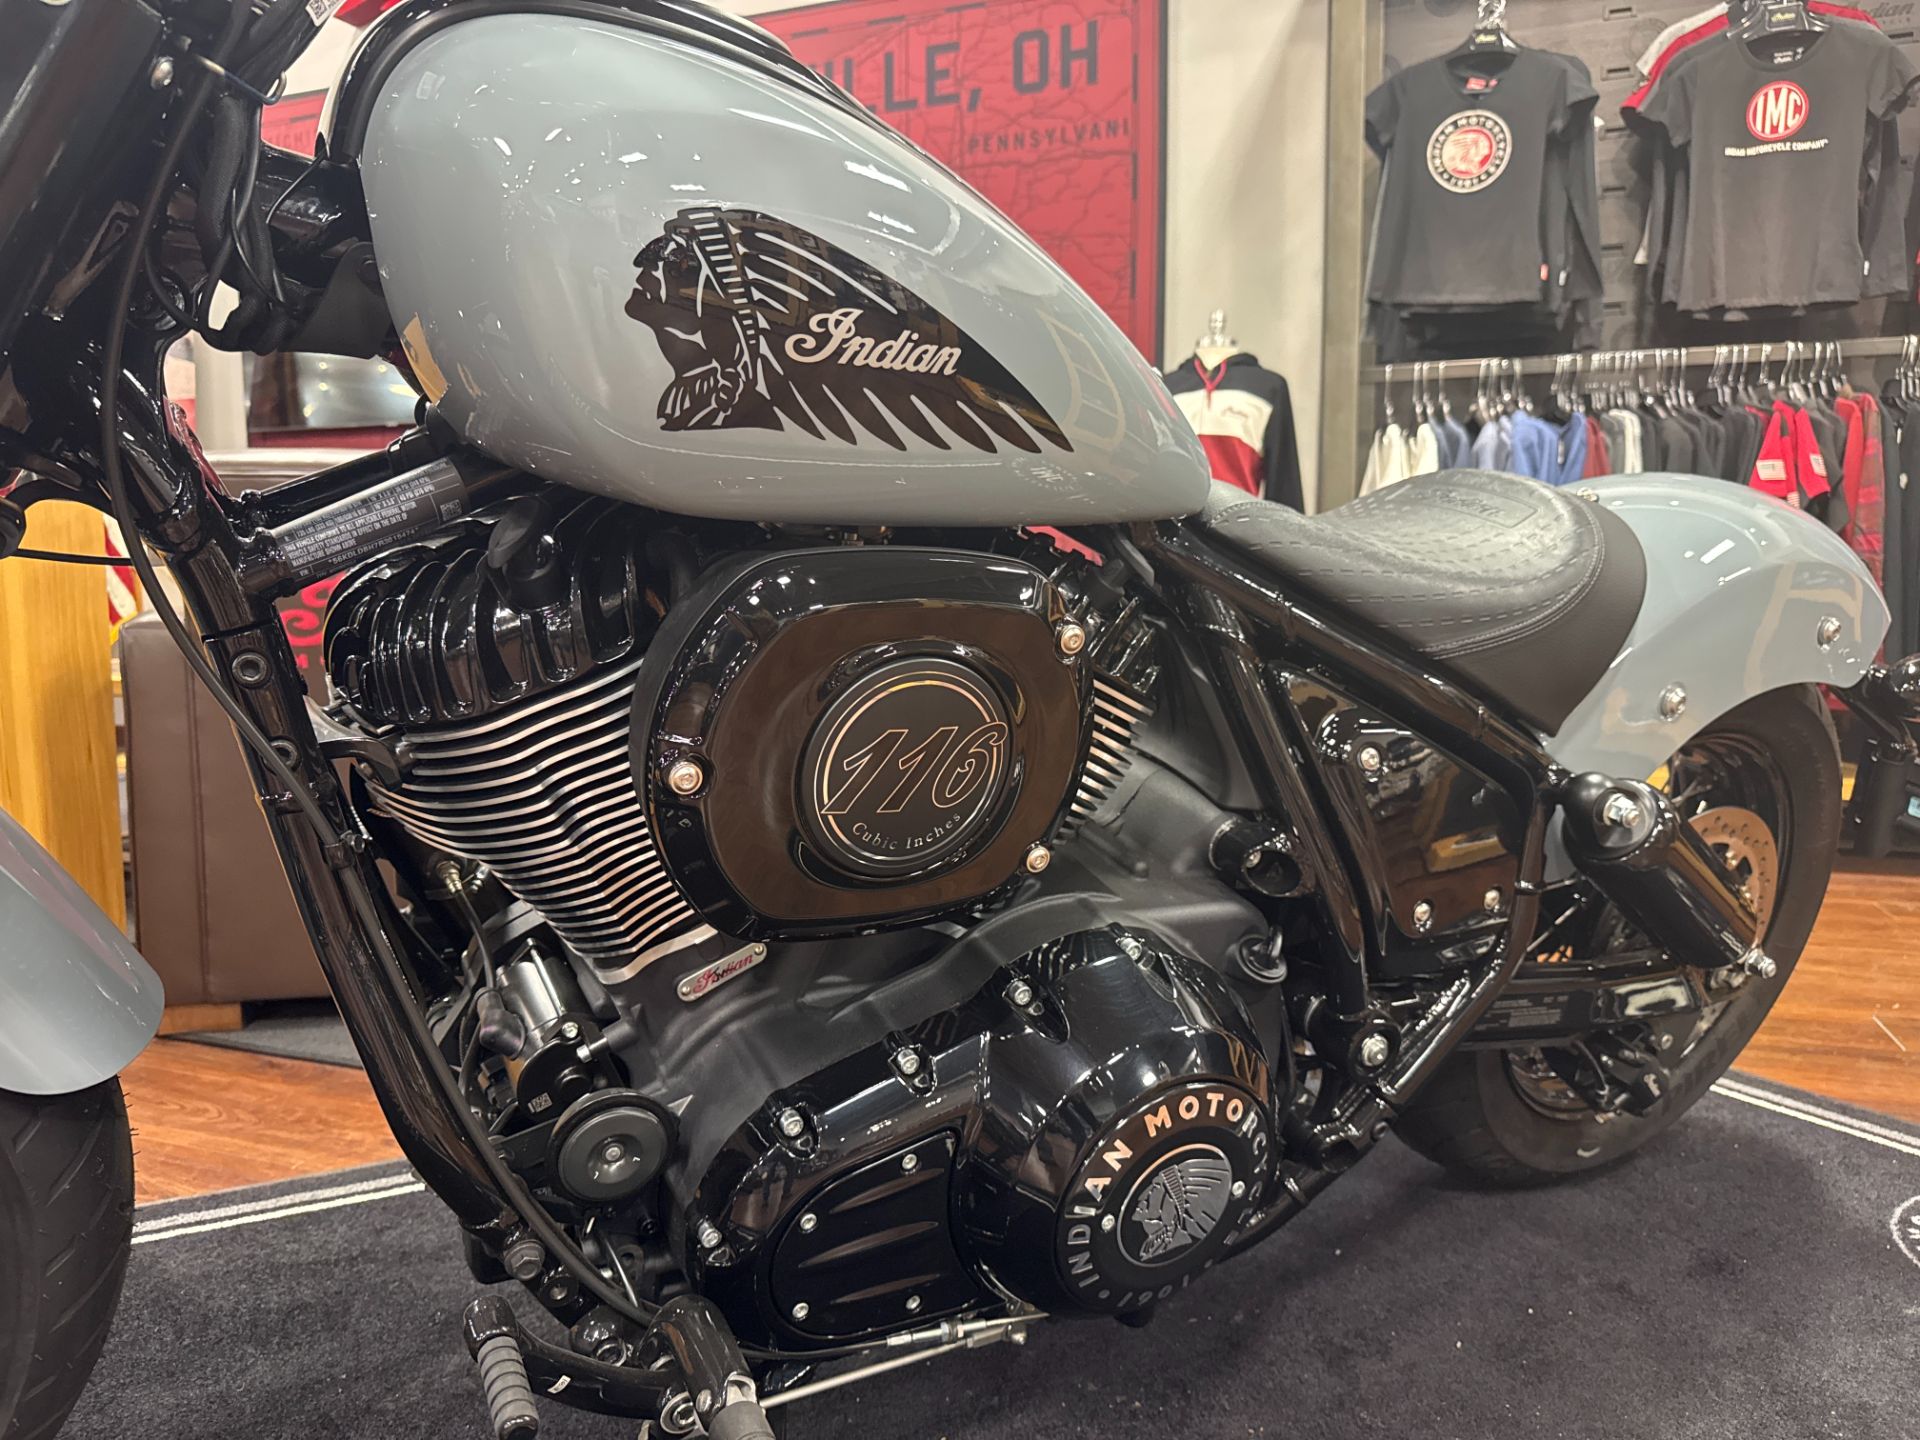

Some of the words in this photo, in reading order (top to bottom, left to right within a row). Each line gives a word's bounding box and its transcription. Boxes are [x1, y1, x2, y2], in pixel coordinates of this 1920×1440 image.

[1013, 20, 1098, 95] OH
[1755, 87, 1802, 135] IMC
[968, 118, 1130, 154] PENNSYLVANI
[1746, 142, 1791, 156] MOTORCYCLE
[784, 307, 962, 376] Indian
[288, 547, 308, 560] VEHICLE
[307, 541, 325, 553] SAFETY
[324, 532, 352, 548] STANDARDS
[357, 524, 374, 536] EFFECT
[295, 536, 316, 549] VEHICLE
[315, 527, 340, 542] CONFORMS
[355, 512, 382, 527] APPLICABLE
[381, 506, 401, 518] FEDERAL
[291, 550, 326, 567] MANUFACTURE
[821, 721, 1008, 814] 116
[852, 821, 898, 850] Cubic
[905, 812, 961, 849] Inches
[1067, 1138, 1133, 1289] INDIAN
[1143, 1092, 1268, 1246] MOTORCYCLE
